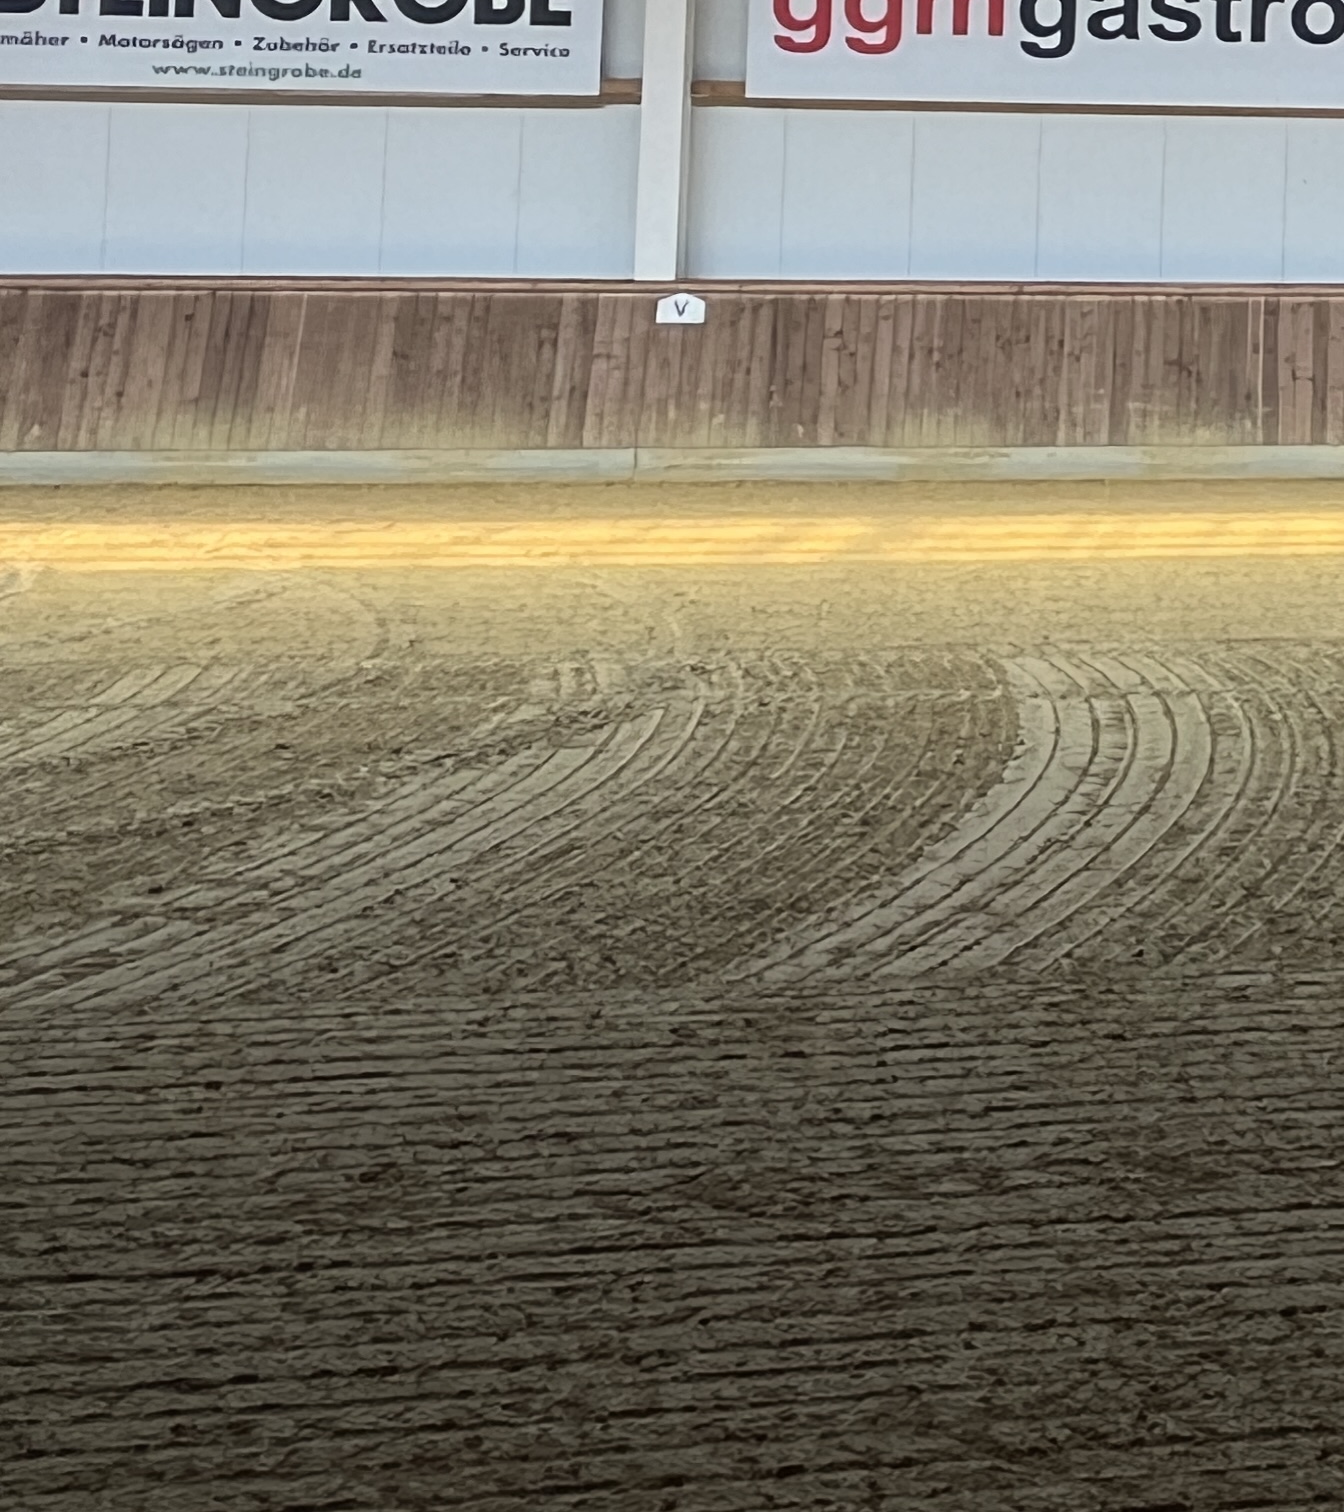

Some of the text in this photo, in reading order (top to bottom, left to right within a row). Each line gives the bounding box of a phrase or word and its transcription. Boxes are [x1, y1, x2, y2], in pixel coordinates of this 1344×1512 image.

[98, 33, 224, 54] Motorsägen
[252, 36, 341, 53] Zubehör
[367, 39, 472, 56] Ersatzteile
[499, 42, 571, 58] Service
[151, 61, 363, 82] www.steingrobe.de
[674, 299, 690, 317] V
